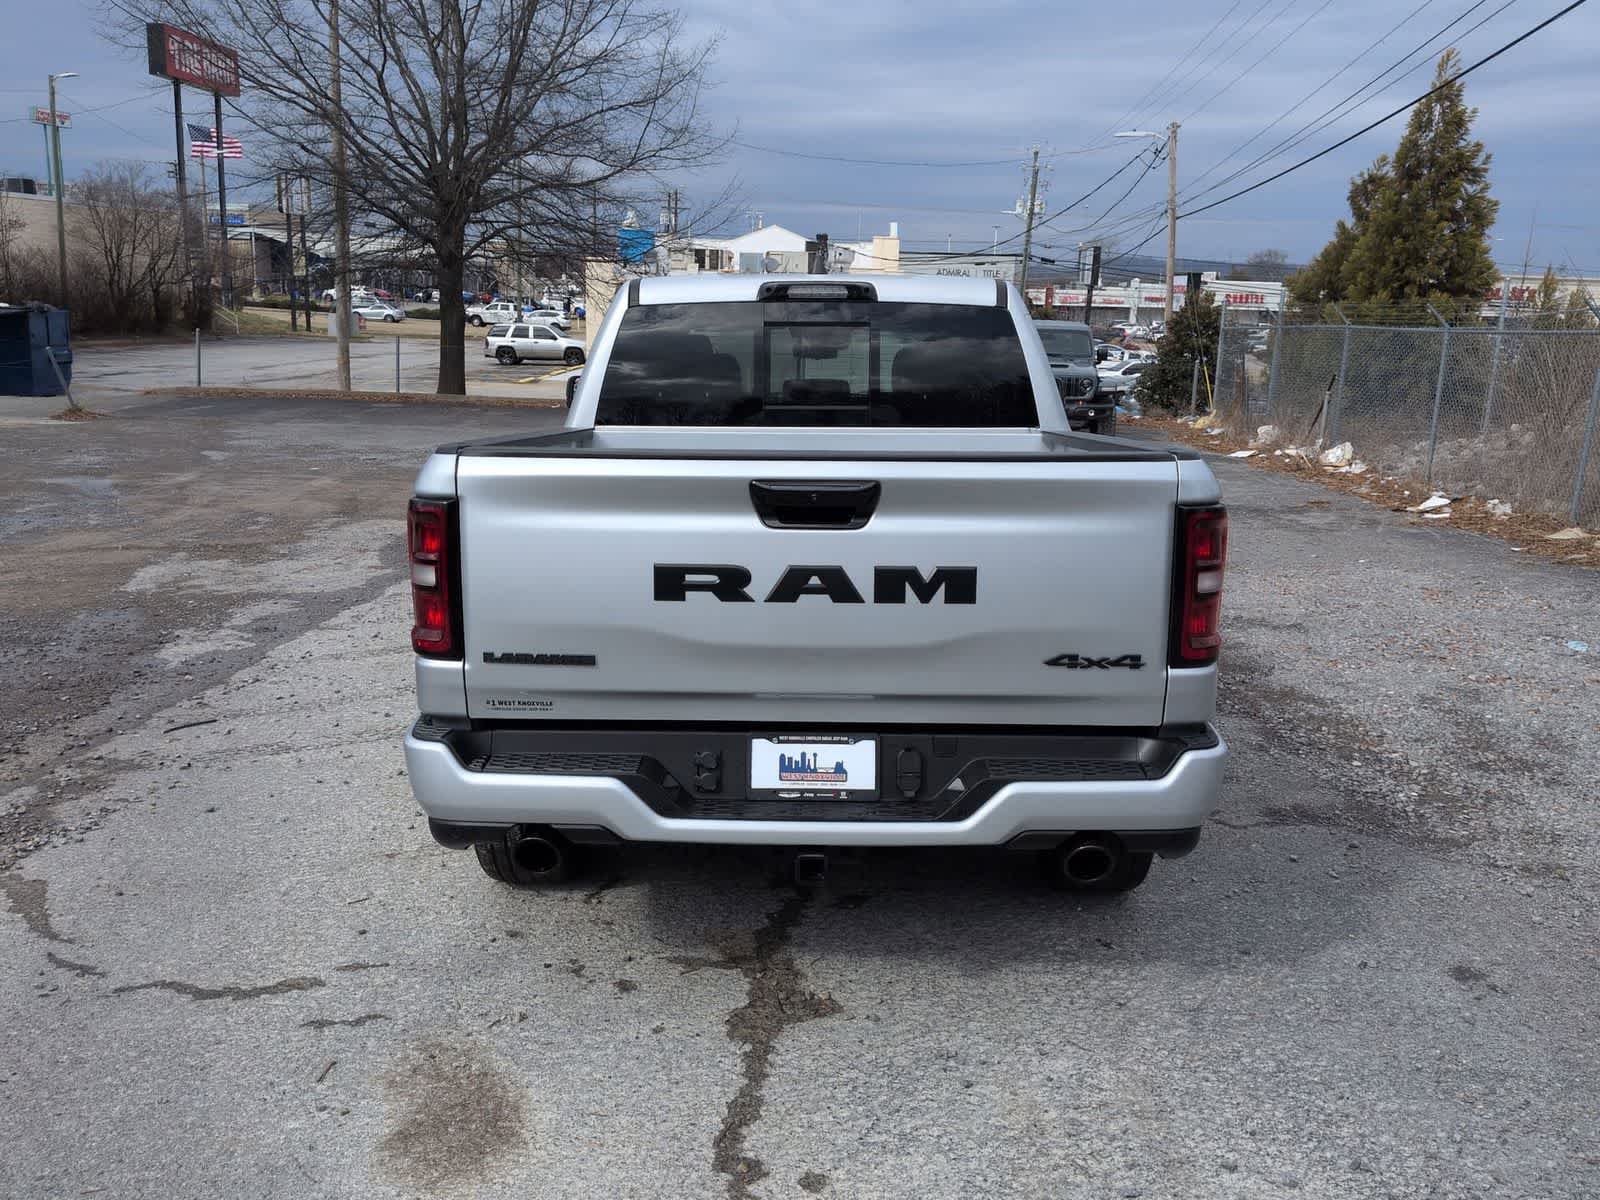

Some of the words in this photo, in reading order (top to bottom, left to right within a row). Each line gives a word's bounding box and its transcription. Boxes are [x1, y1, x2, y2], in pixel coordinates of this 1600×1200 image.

[936, 268, 970, 277] ADMIRAL
[983, 269, 1001, 278] TITLE
[653, 563, 978, 604] RAM
